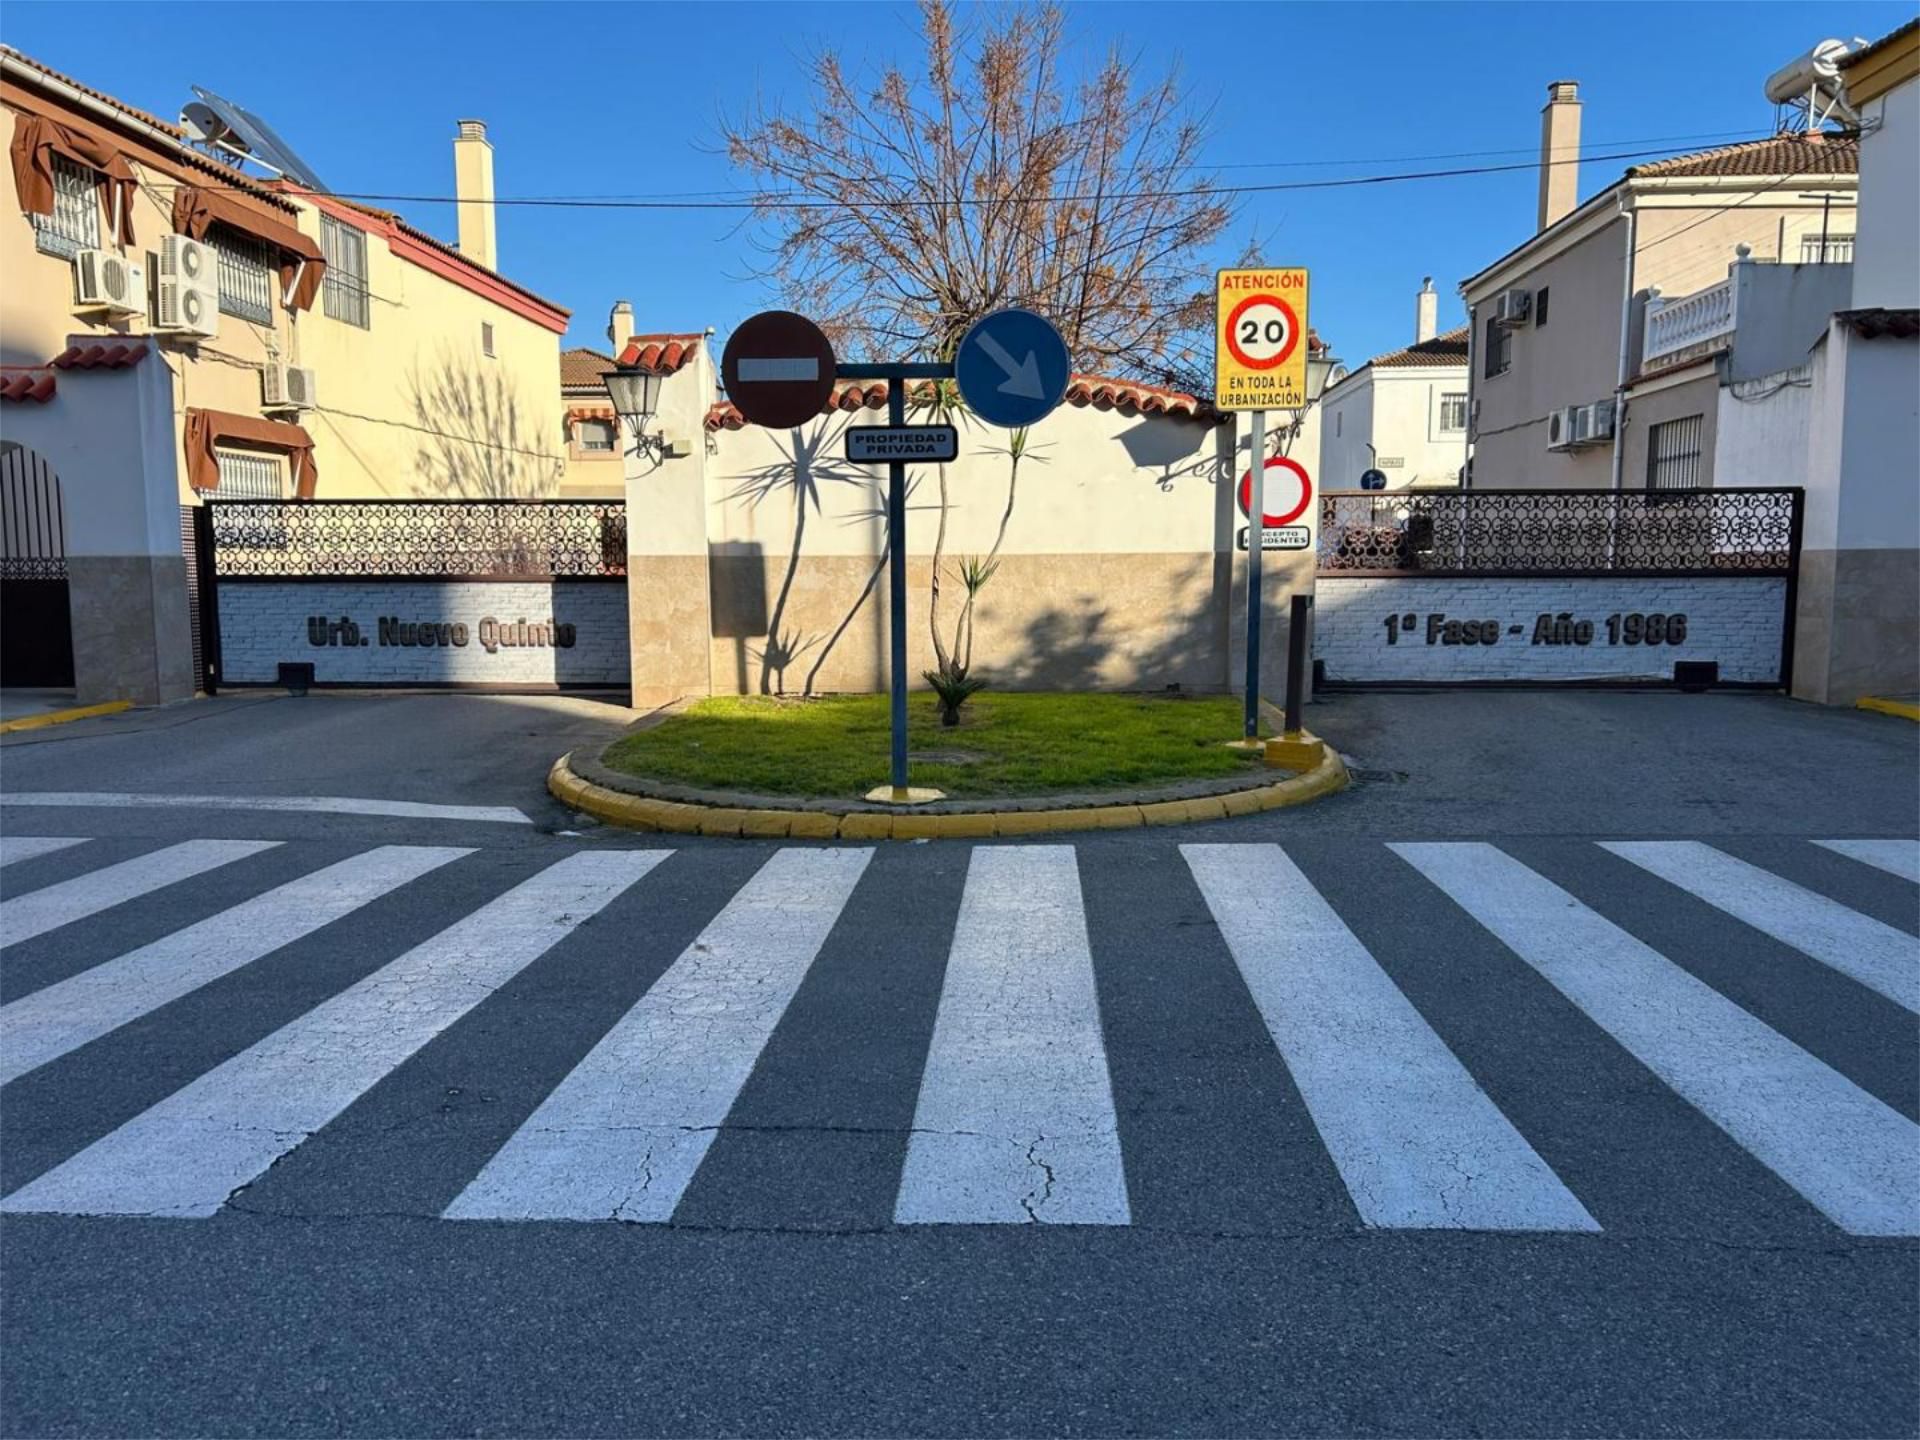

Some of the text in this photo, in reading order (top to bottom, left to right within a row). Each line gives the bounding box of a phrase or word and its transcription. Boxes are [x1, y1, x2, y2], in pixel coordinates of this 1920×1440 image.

[1223, 270, 1304, 289] ATENCIÓN
[1241, 320, 1284, 344] 20
[1230, 375, 1292, 389] EN TODA LA
[1220, 390, 1301, 406] URBANIZACIÓN
[855, 433, 946, 444] PROPIEDAD
[866, 444, 936, 454] PRIVADA
[307, 616, 577, 653] Urb. Nuevo Quinto
[1426, 613, 1500, 646] Fase
[1531, 612, 1594, 646] Año
[1605, 613, 1688, 646] 1986
